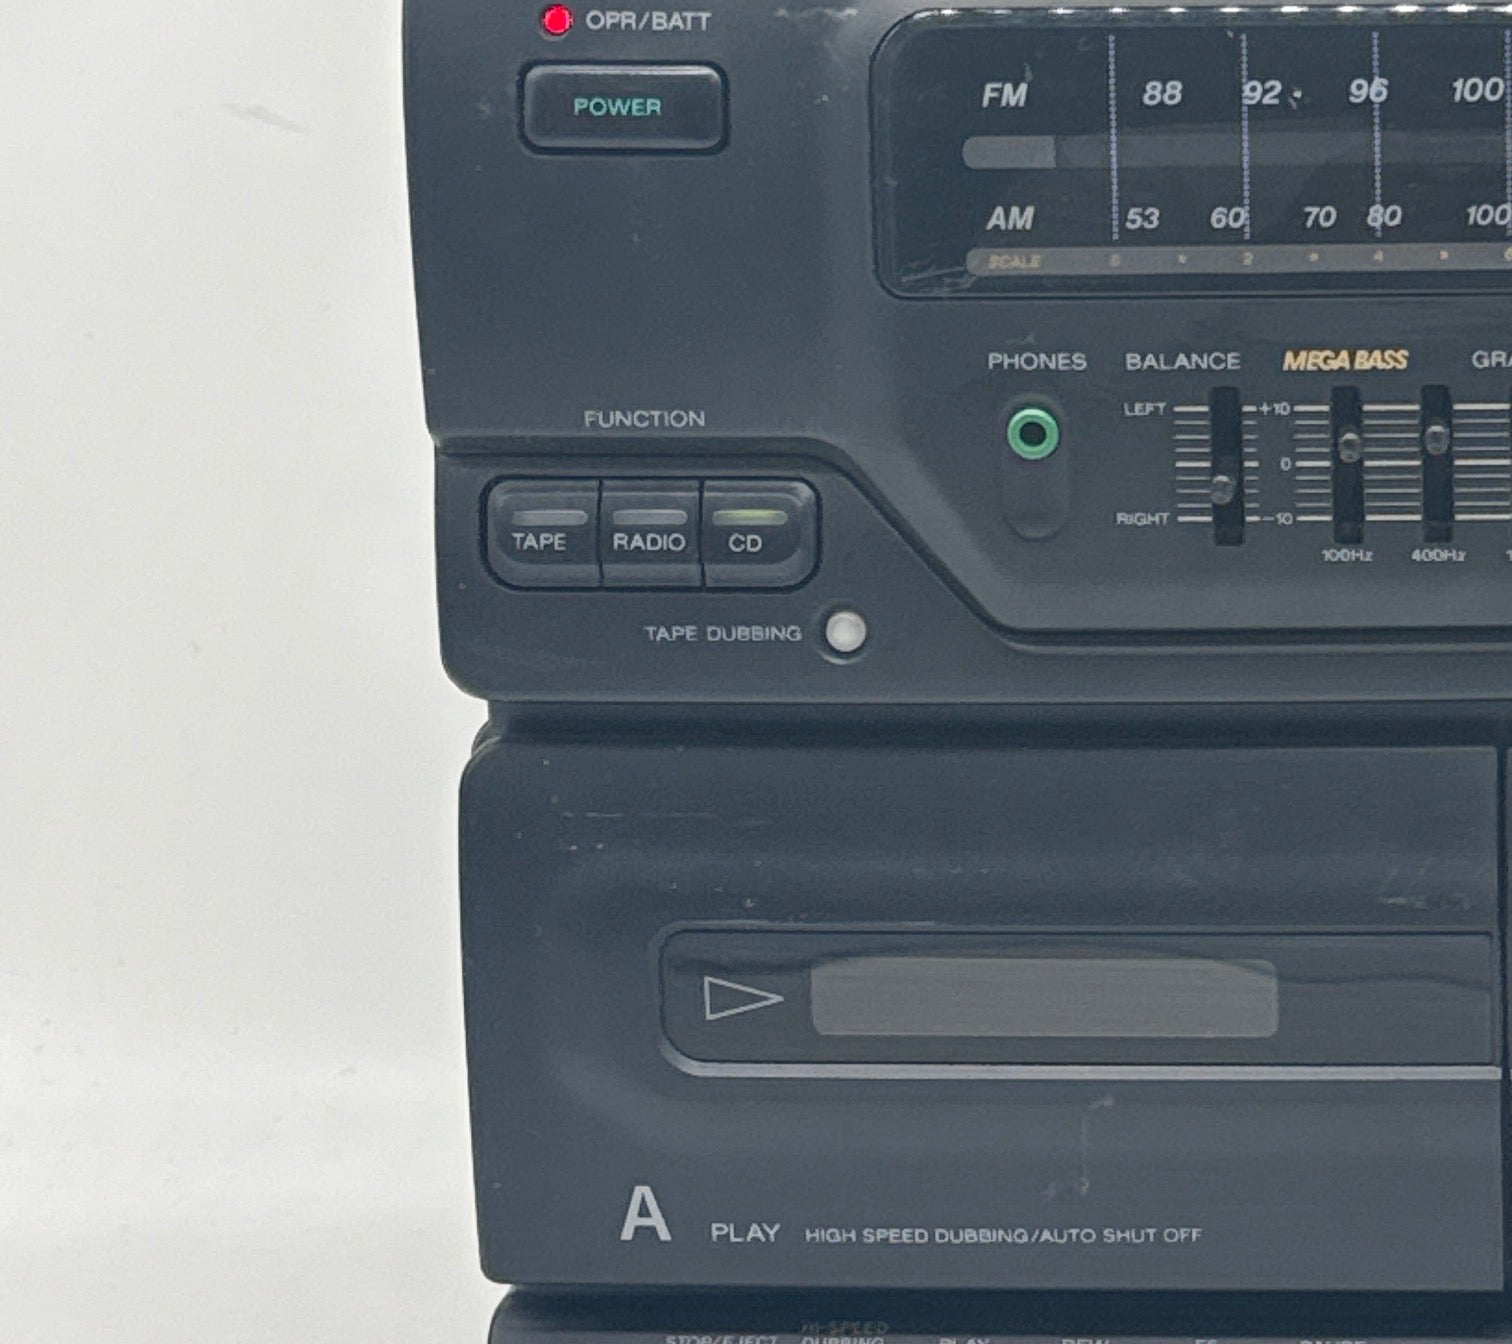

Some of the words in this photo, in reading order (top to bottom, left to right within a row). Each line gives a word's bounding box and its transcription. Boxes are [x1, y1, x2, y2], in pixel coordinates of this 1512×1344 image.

[586, 10, 712, 32] OPR/BATT
[982, 82, 1028, 109] FM
[1142, 80, 1183, 106] 88
[1243, 79, 1283, 106] 92
[1348, 77, 1389, 105] 96
[1452, 76, 1505, 103] 100
[573, 97, 662, 117] POWER
[985, 205, 1036, 231] AM
[1124, 207, 1160, 231] 53
[1209, 206, 1246, 231] 60
[1302, 205, 1338, 229] 70
[1366, 204, 1404, 228] 80
[1467, 203, 1512, 227] 100
[987, 254, 1042, 270] SCALE
[988, 353, 1088, 372] PHONES
[1125, 353, 1241, 372] BALANCE
[1283, 349, 1351, 371] MEGA
[1354, 349, 1410, 370] BASS
[1123, 402, 1167, 416] LEFT
[584, 410, 705, 429] FUNCTION
[1116, 512, 1170, 526] RIGHT
[512, 533, 566, 551] TAPE
[613, 533, 686, 552] RADIO
[728, 534, 763, 553] CD
[1322, 548, 1374, 562] 100Hz
[1411, 548, 1467, 562] 400Hz
[643, 625, 698, 642] TAPE
[706, 625, 803, 643] DUBBING
[620, 1185, 672, 1242] A
[710, 1223, 782, 1244] PLAY
[804, 1228, 857, 1244] HIGH
[862, 1228, 929, 1244] SPEED
[934, 1228, 1096, 1245] DUBBING/AUTO
[1102, 1228, 1159, 1244] SHUT
[1164, 1228, 1204, 1244] OFF
